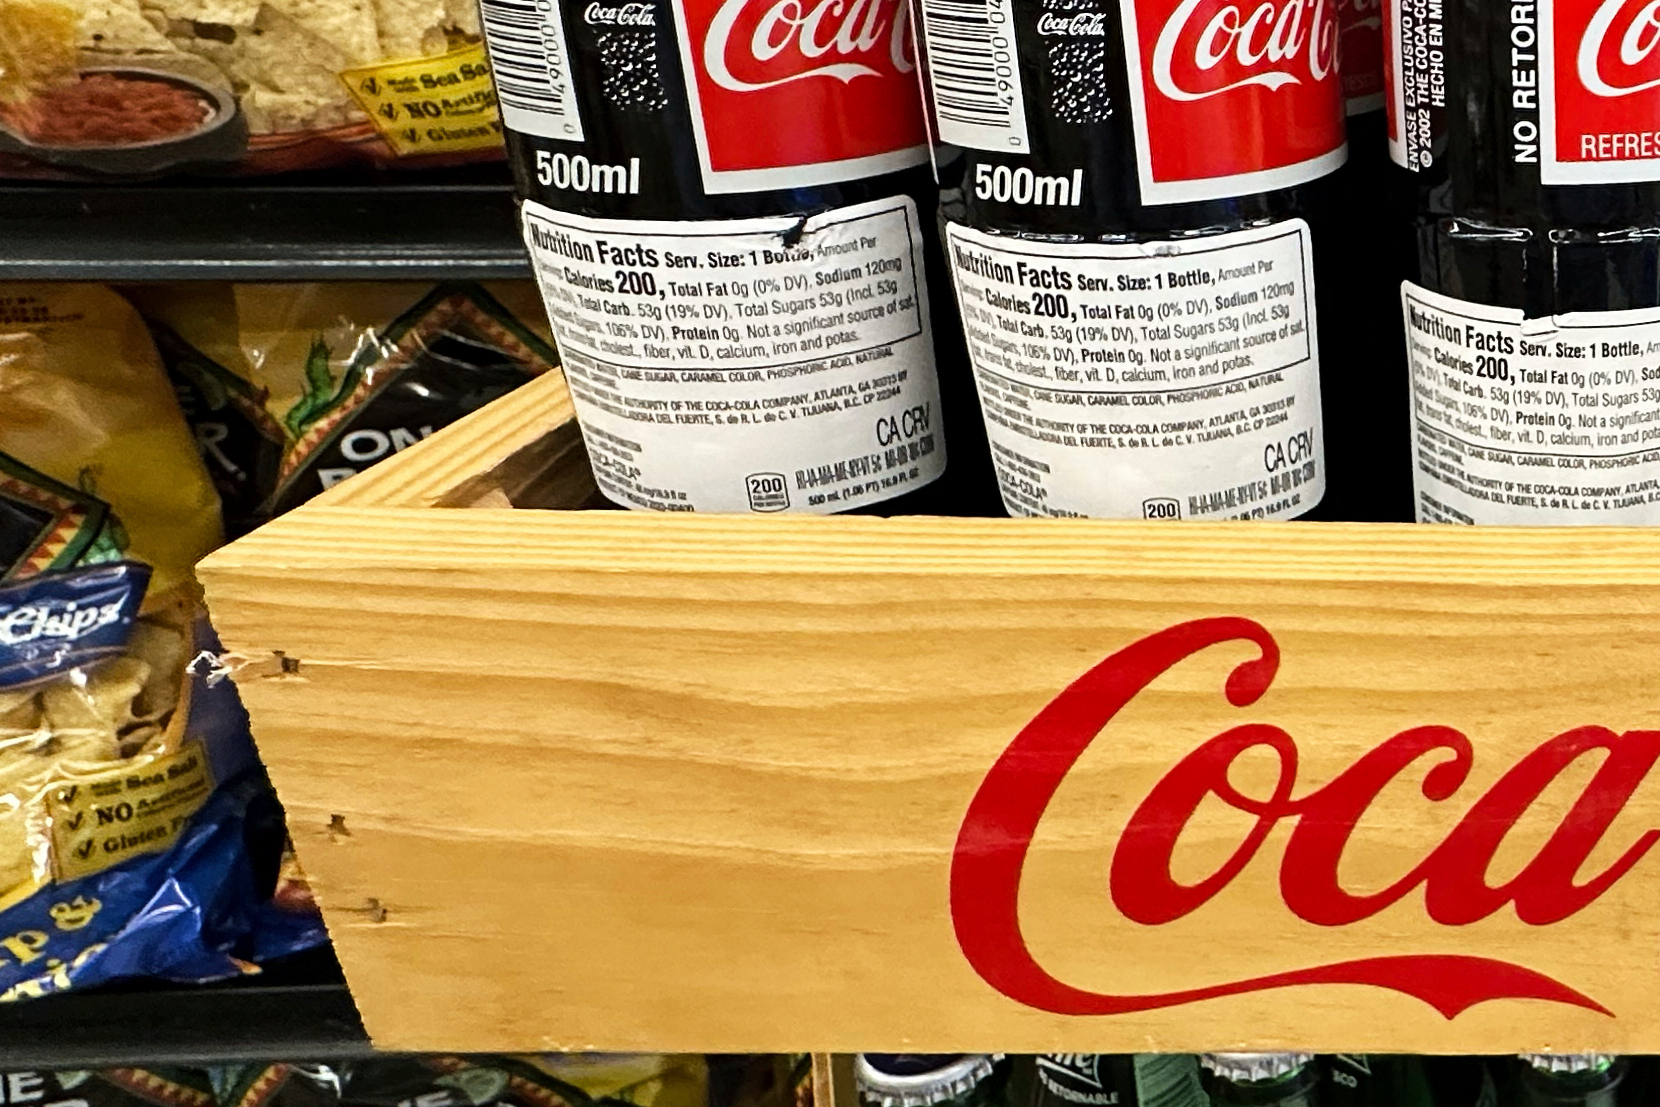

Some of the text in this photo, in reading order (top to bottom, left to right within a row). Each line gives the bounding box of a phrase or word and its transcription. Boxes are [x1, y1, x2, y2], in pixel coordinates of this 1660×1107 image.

[583, 1, 657, 28] Coca-Cola
[1036, 12, 1106, 37] Coca-Cola
[1430, 27, 1443, 48] EN
[1404, 16, 1416, 108] EXCLUSIVO
[1431, 49, 1445, 107] HECHO
[403, 100, 442, 120] NO
[1417, 78, 1429, 105] THE
[1405, 111, 1420, 172] ENVASE
[1418, 108, 1431, 149] 2002
[1513, 120, 1538, 165] NO
[536, 150, 641, 194] 500ml
[975, 164, 1083, 207] 500ml
[530, 222, 758, 269] Nutrition Facts Serv. Size: 1
[564, 265, 615, 294] Calories
[615, 269, 667, 300] 200,
[955, 244, 1216, 292] Nutrition Facts Serv. Size: 1 Bottle,
[985, 287, 1078, 323] Calories 200,
[1409, 302, 1644, 359] Nutrition Facts Serv. Size: 1 Bottle,
[1433, 346, 1516, 386] Calories 200,
[876, 401, 931, 447] CA CRV
[1263, 427, 1314, 473] CA CRV
[751, 478, 783, 494] 200
[1147, 502, 1176, 519] 200
[95, 801, 134, 827] NO
